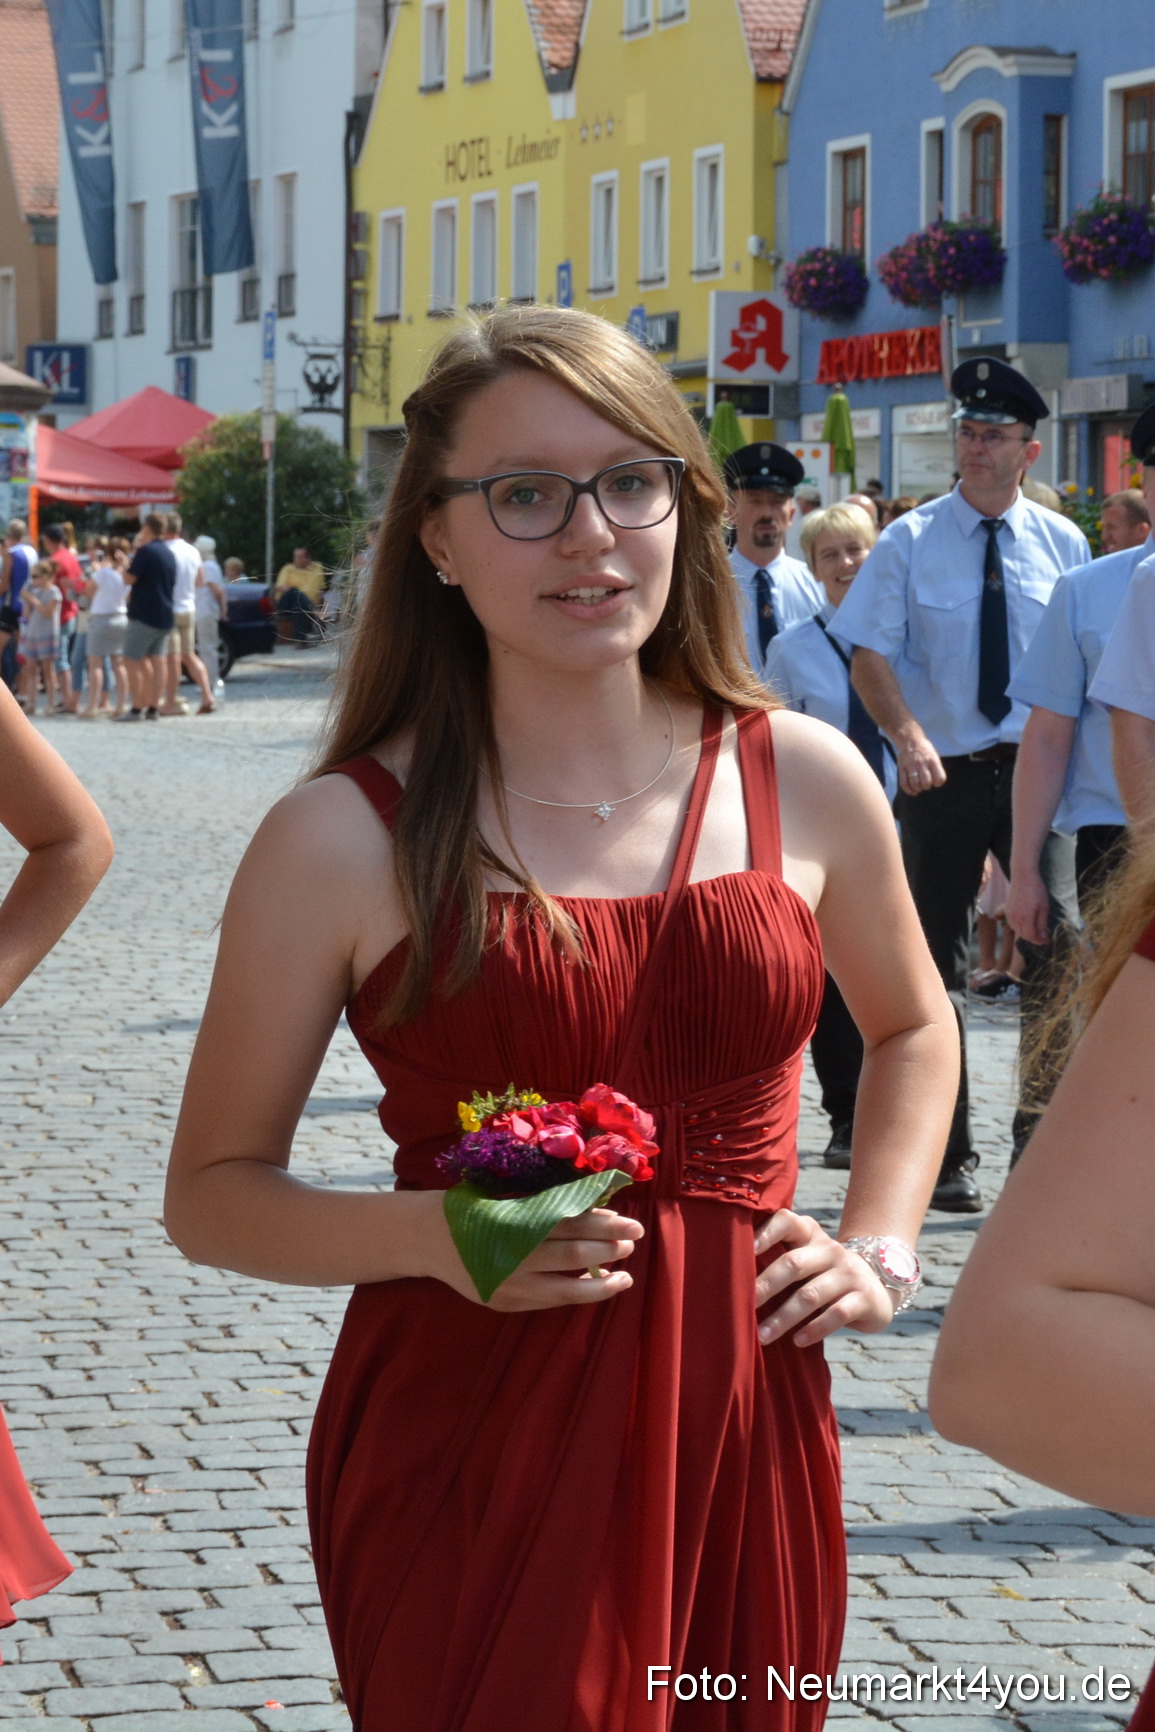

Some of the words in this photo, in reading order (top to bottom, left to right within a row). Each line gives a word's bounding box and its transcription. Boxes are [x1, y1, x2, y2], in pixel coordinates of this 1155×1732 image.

[445, 136, 493, 183] HOTEL
[505, 129, 561, 169] Lehmeier
[816, 325, 941, 385] APOTHEKE
